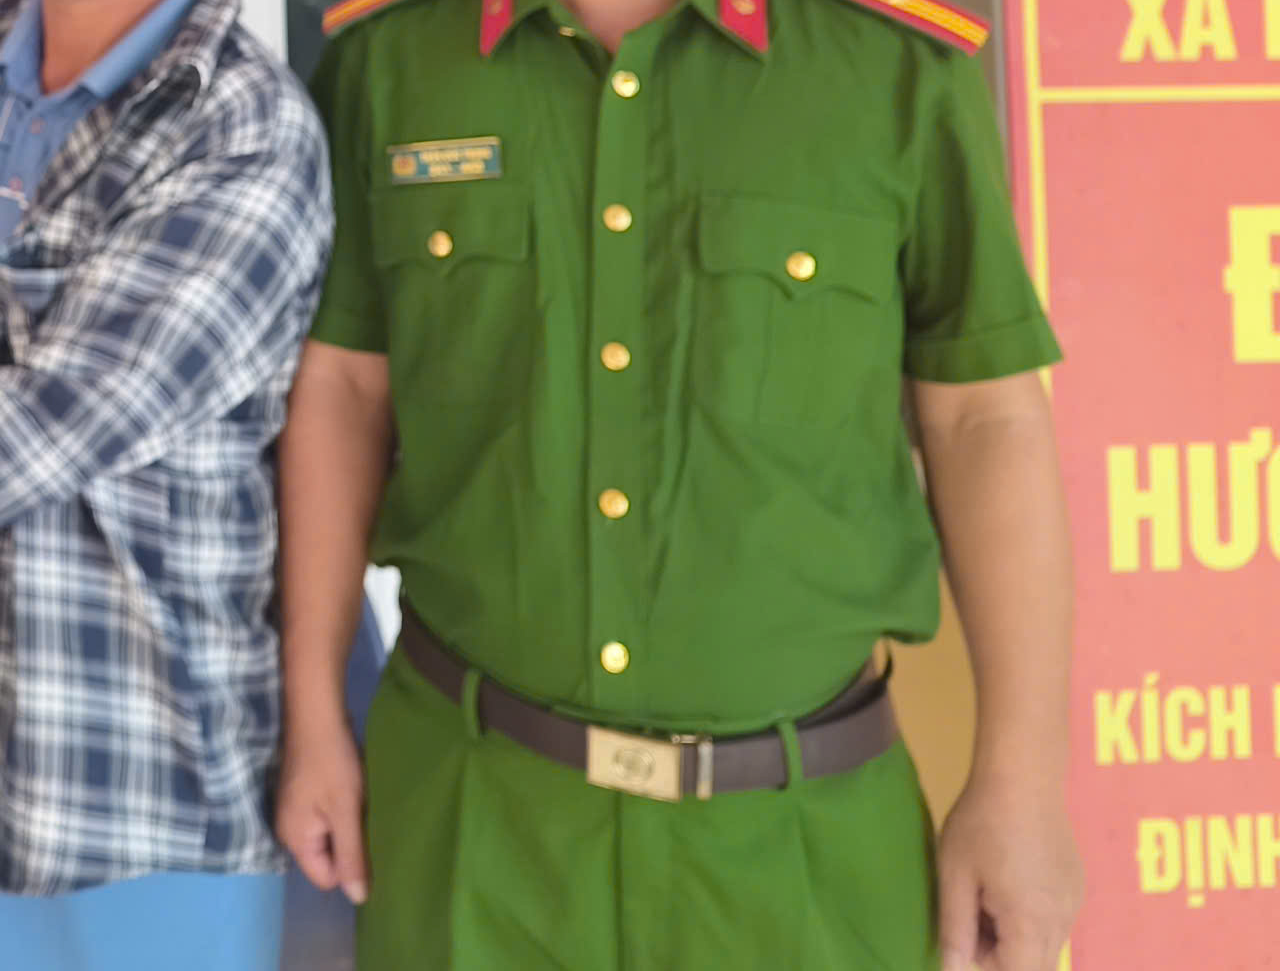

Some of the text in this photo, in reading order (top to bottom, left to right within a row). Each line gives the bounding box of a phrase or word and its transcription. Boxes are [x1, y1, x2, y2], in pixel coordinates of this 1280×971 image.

[1107, 427, 1280, 573] HƯ
[1094, 670, 1252, 766] KÍCH
[1135, 813, 1280, 910] ĐỊNH
